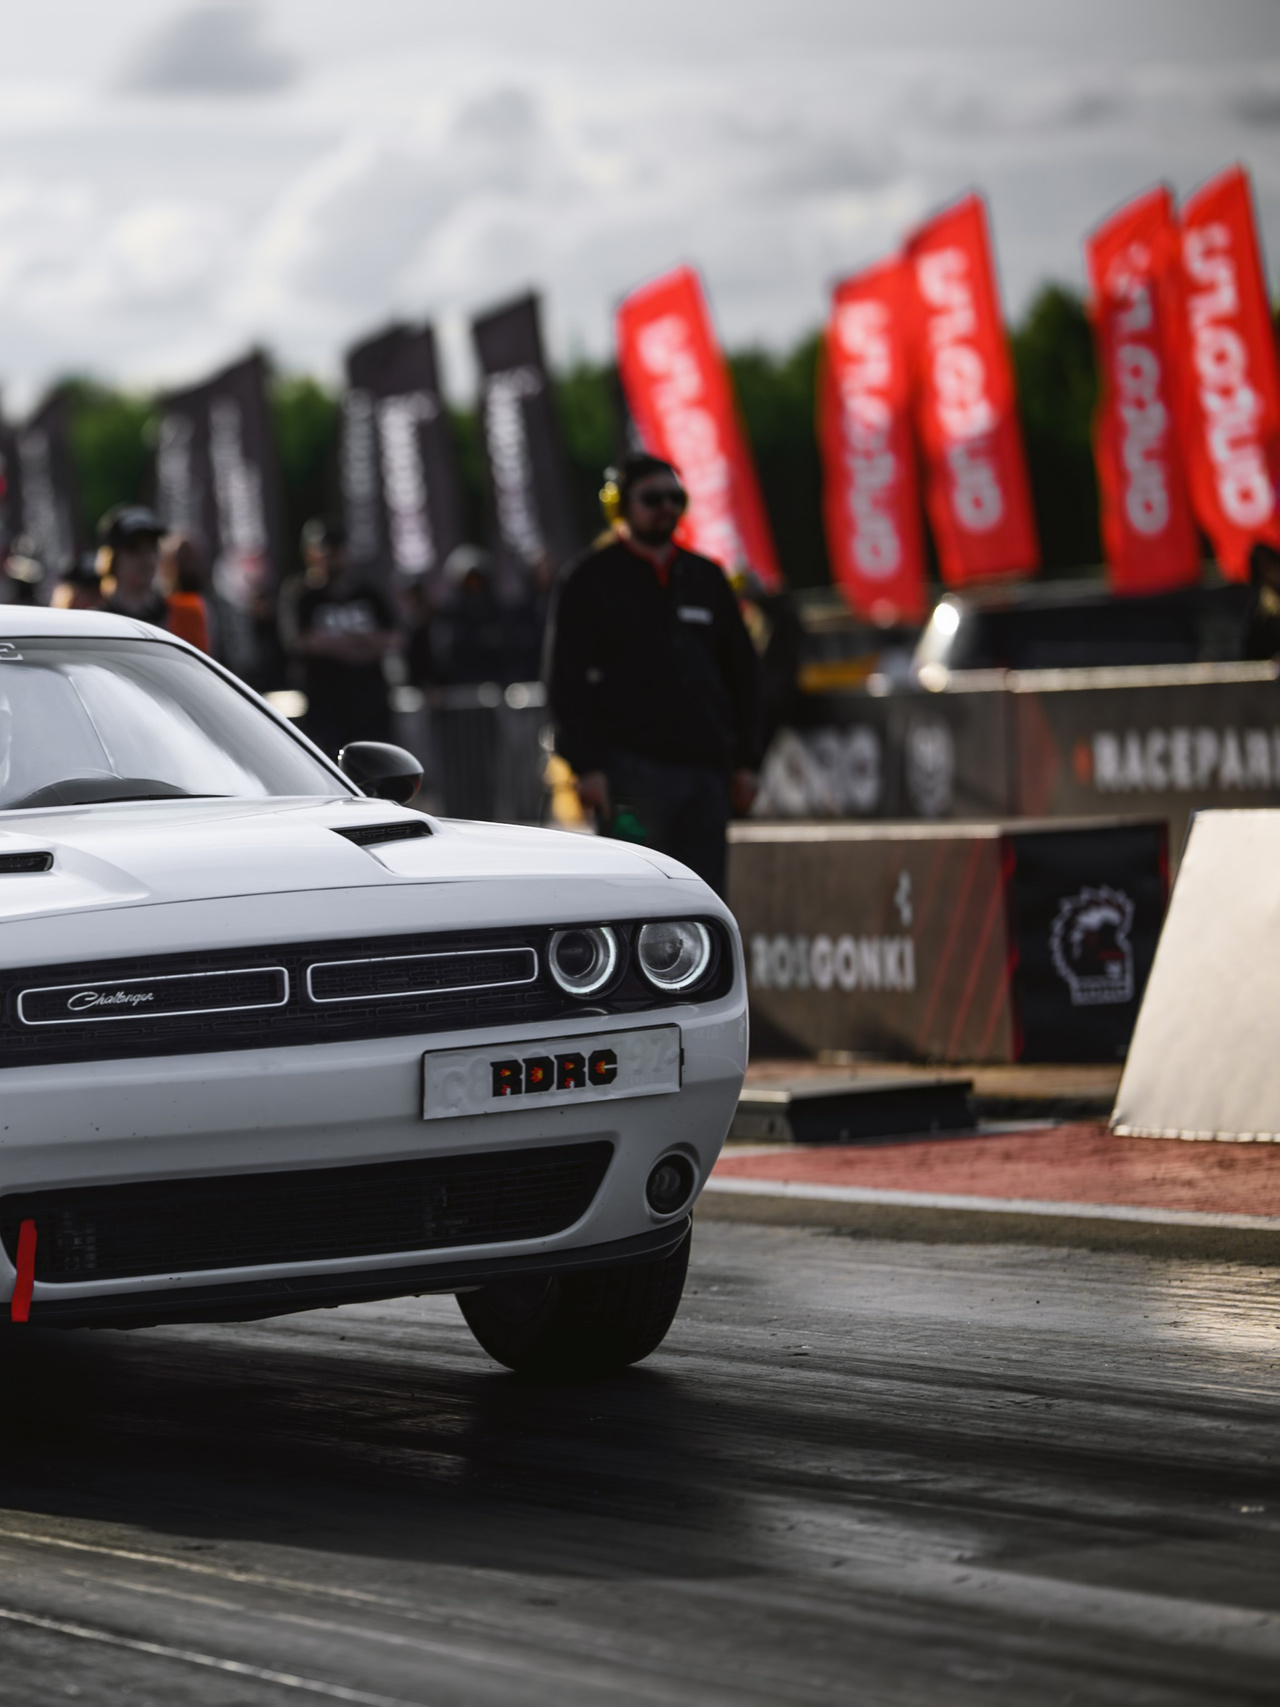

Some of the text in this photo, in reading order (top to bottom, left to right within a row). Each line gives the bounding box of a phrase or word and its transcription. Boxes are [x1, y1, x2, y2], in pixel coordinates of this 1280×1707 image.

[1094, 724, 1280, 792] RACEPAR
[66, 991, 154, 1011] Challenger
[490, 1049, 618, 1097] RDRC
